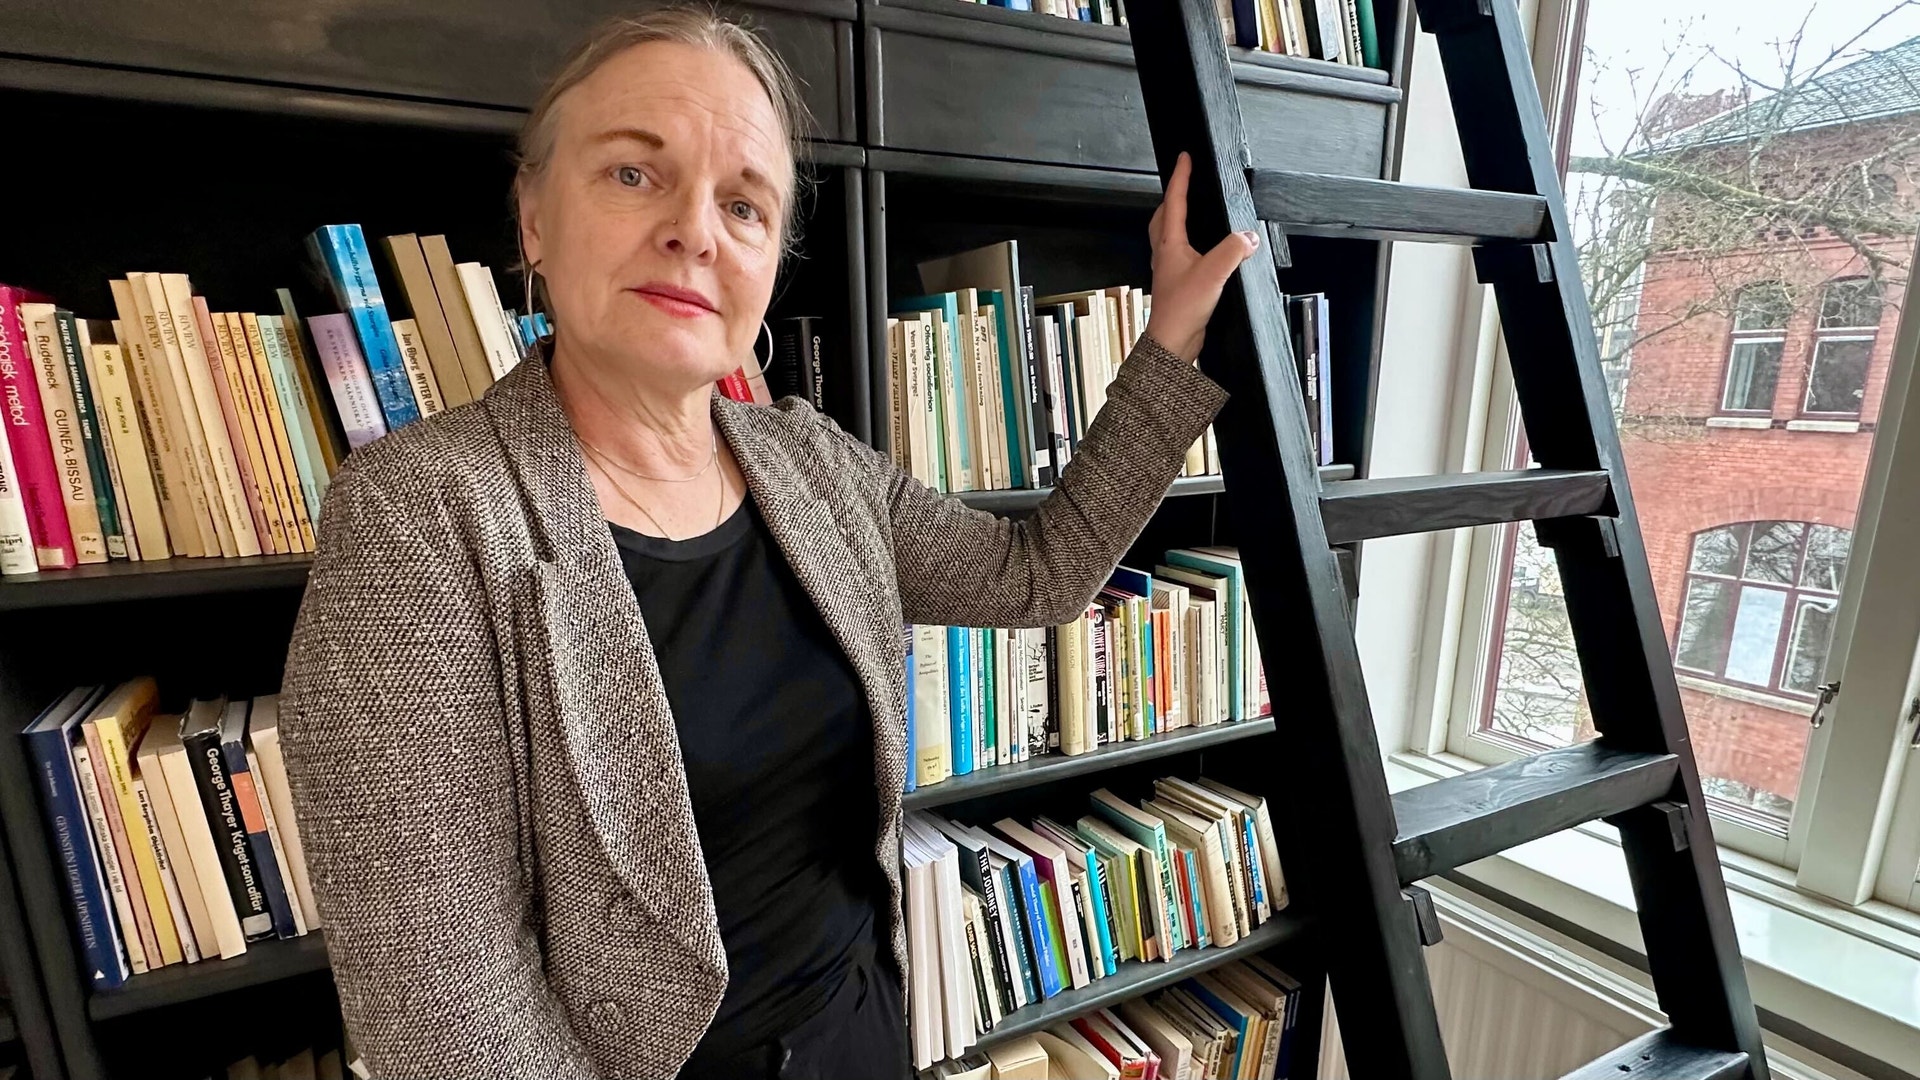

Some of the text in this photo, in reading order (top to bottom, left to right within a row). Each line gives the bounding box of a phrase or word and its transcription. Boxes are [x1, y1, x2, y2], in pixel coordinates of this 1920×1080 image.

[143, 313, 162, 351] REVIEW
[158, 309, 176, 347] REVIEW
[178, 313, 196, 351] REVIEW
[216, 323, 233, 358] REVIEW
[231, 325, 249, 361] REVIEW
[246, 323, 264, 358] REVIEW
[262, 325, 281, 361] REVIEW
[273, 325, 292, 360] REVIEW
[400, 330, 414, 347] Jan
[37, 335, 60, 390] Rudebeck
[810, 335, 825, 409] George Thayer
[4, 385, 30, 426] metod
[413, 371, 437, 414] MYTER OM
[925, 362, 933, 412] socialisation
[55, 408, 85, 502] GUINEA-BISSAU
[203, 746, 240, 830] George Thayer
[54, 814, 75, 864] GEVINSTEN
[66, 863, 83, 894] LIGGER
[75, 898, 97, 950] ÅPENHETEN
[229, 829, 265, 912] Kriget som affär
[977, 852, 999, 918] THE JOURNEY
